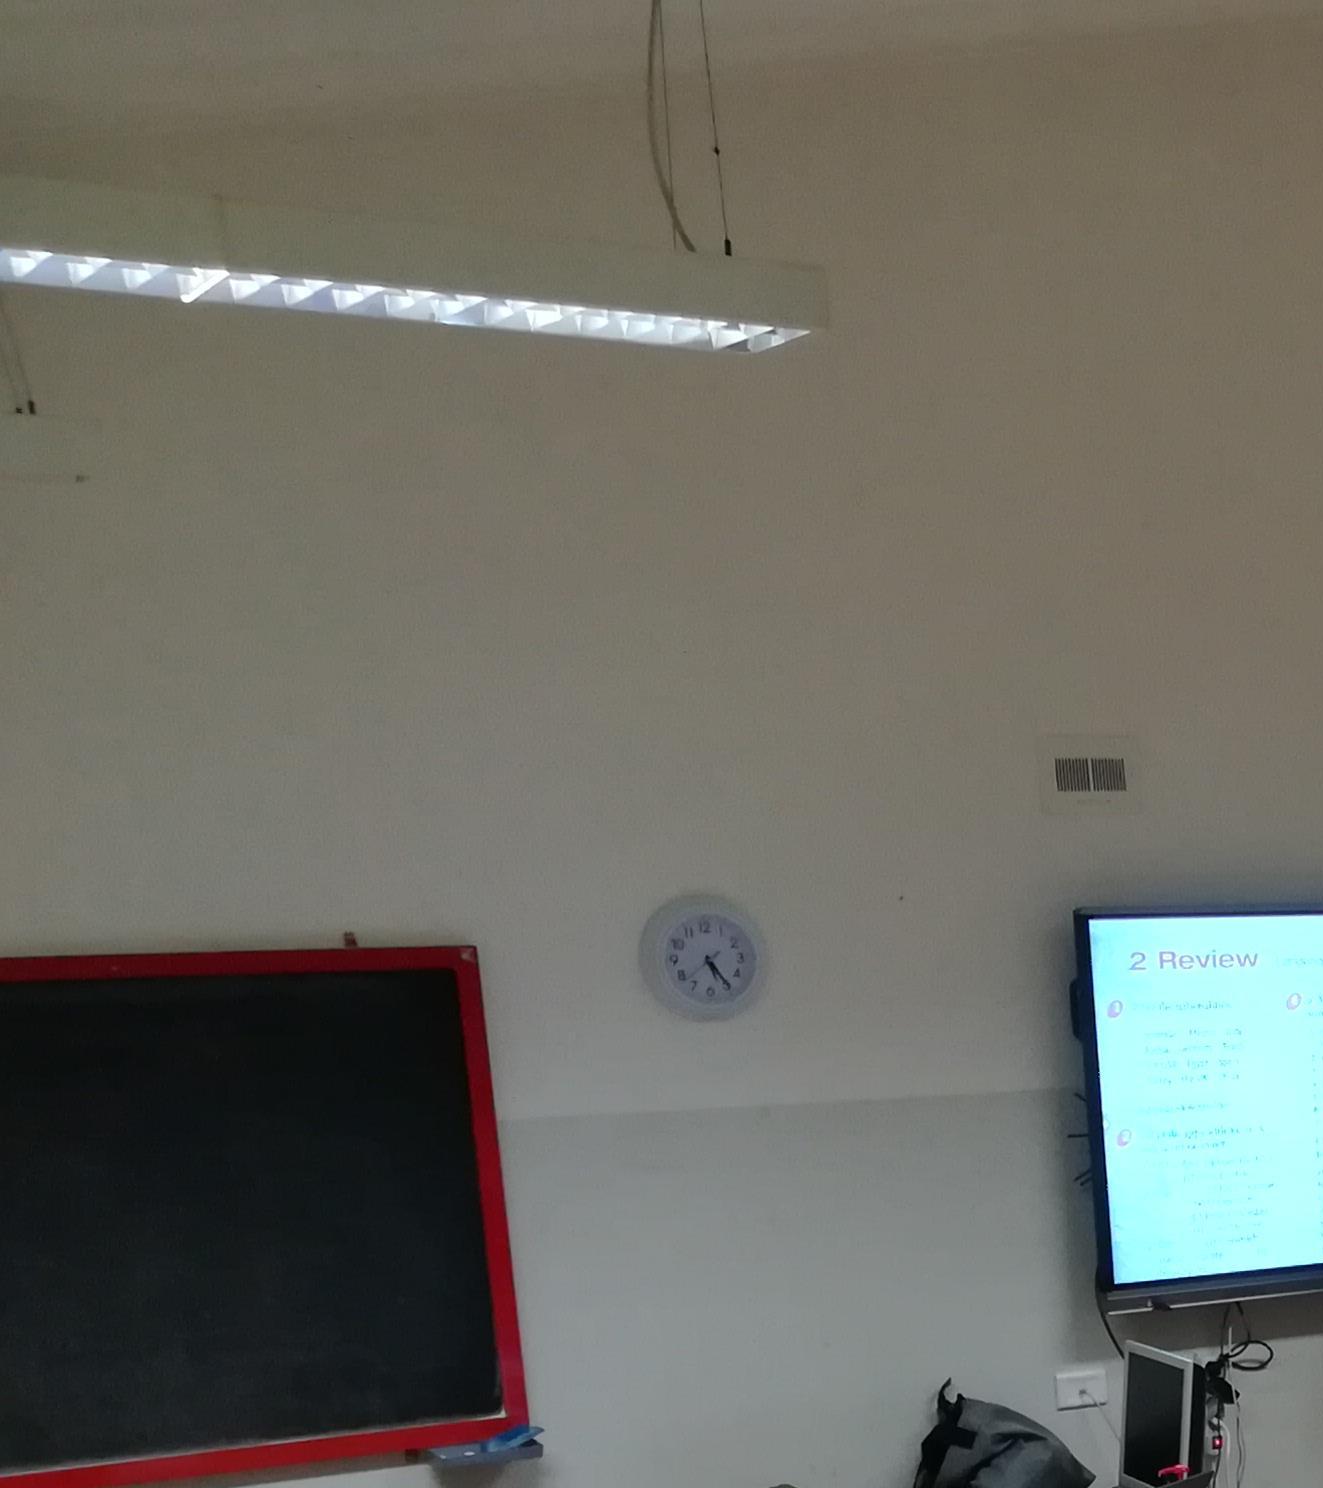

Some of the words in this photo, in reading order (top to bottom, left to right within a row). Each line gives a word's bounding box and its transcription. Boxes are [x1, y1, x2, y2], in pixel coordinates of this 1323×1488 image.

[684, 926, 694, 939] 11
[699, 920, 712, 934] 12
[671, 938, 685, 951] 10
[729, 936, 739, 949] 2
[669, 953, 679, 967] 9
[736, 952, 745, 964] 3
[1128, 951, 1147, 971] 2
[1158, 949, 1259, 970] Review
[677, 969, 687, 981] 8
[732, 968, 741, 978] 4
[690, 980, 698, 992] 7
[706, 985, 716, 997] 6
